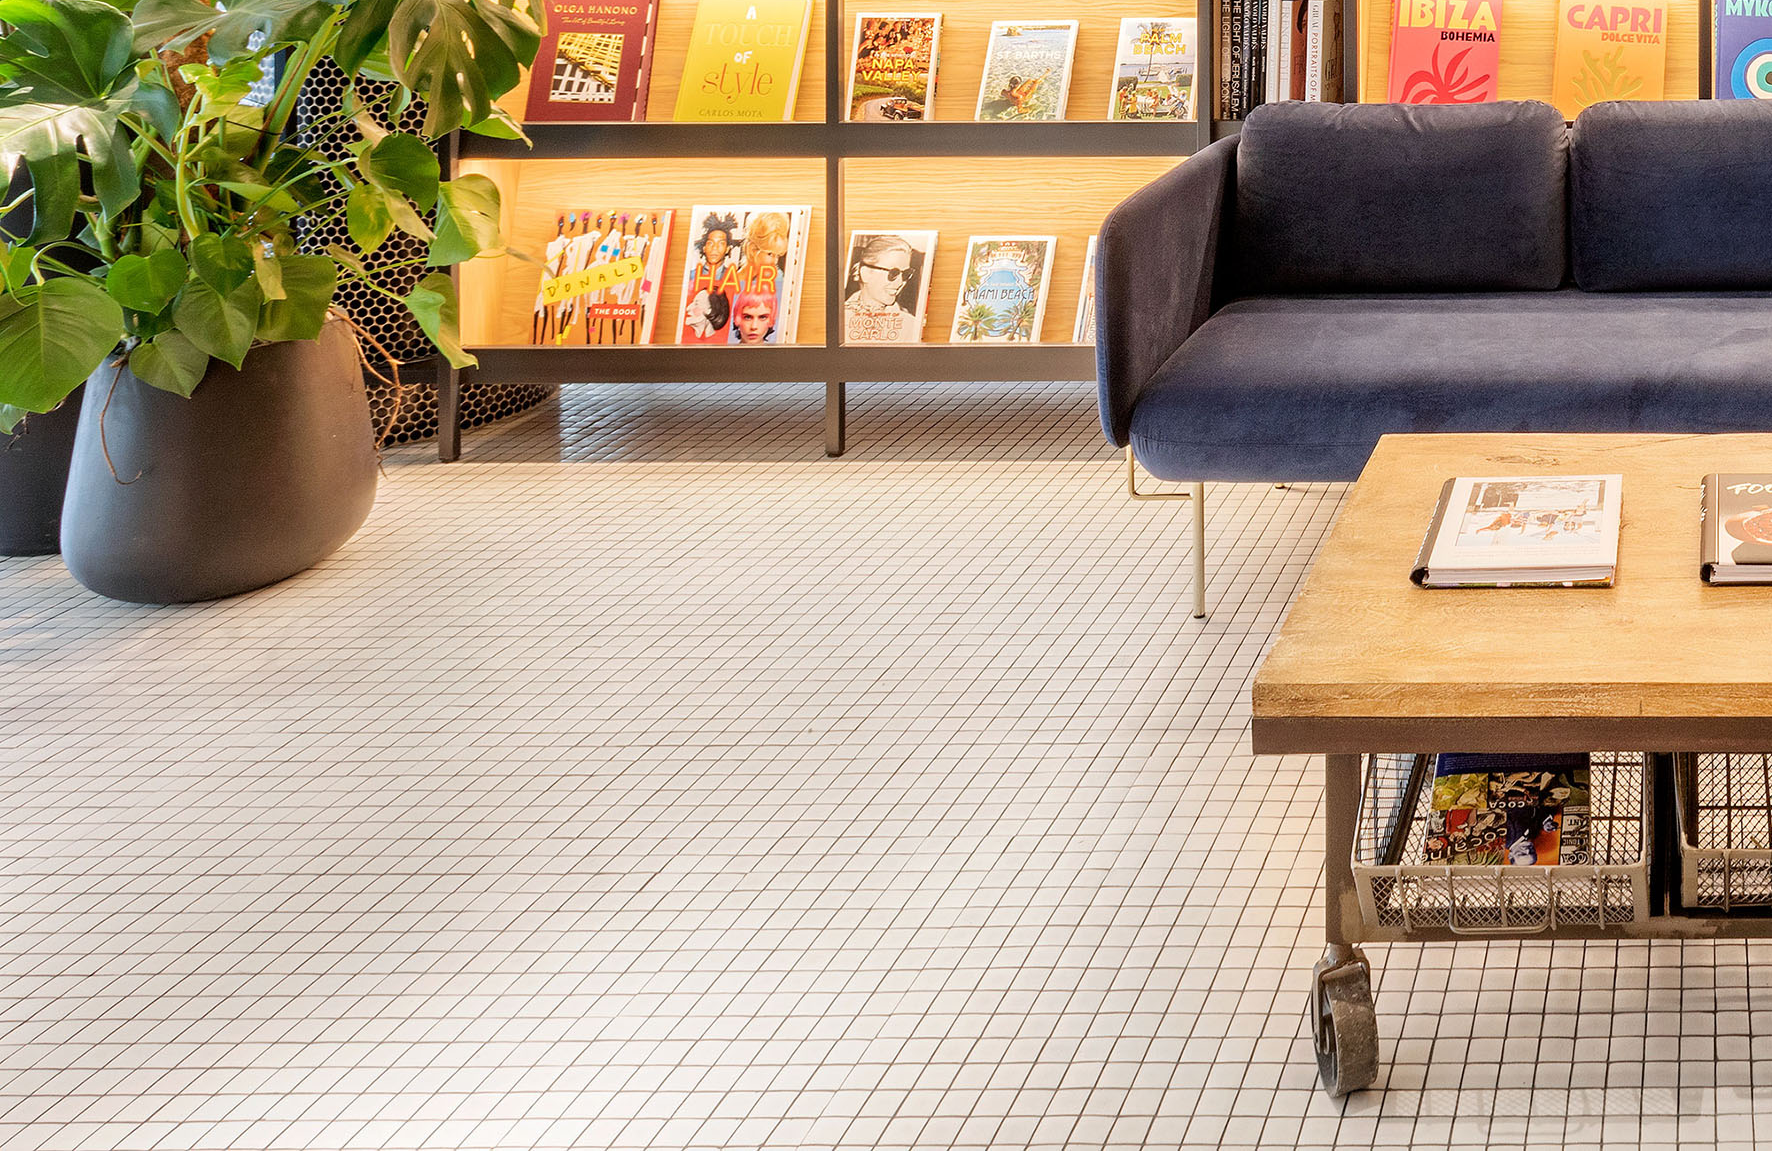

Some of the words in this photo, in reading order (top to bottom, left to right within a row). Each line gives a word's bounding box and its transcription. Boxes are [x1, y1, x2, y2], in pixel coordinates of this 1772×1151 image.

[553, 4, 584, 14] OLGA
[588, 5, 638, 15] HANONO
[745, 5, 758, 20] A
[1567, 4, 1663, 34] CAPRI
[704, 23, 795, 48] TOUCH
[1222, 16, 1230, 43] LIGHT
[1232, 16, 1241, 43] LIGHT
[1139, 33, 1184, 44] PALM
[1440, 30, 1496, 44] BOHEMIA
[1601, 32, 1635, 44] DOLCE
[1636, 33, 1661, 45] VITA
[1014, 50, 1063, 60] BARTHS
[1132, 43, 1187, 55] BEACH
[1232, 46, 1240, 59] OF
[1310, 32, 1318, 78] PORTRAITS
[734, 50, 753, 64] OF
[872, 59, 914, 70] NAPA
[861, 70, 922, 81] VALLEY
[701, 63, 774, 104] style
[1231, 60, 1240, 112] JERUSALEM
[1310, 79, 1318, 91] OF
[698, 108, 734, 117] CARLOS
[736, 109, 763, 118] MOTA
[546, 262, 639, 298] DONALD
[695, 265, 777, 294] HAIR
[966, 288, 999, 300] MIAMI
[1001, 288, 1036, 301] BEACH
[594, 307, 611, 315] THE
[612, 308, 637, 316] BOOK
[848, 317, 904, 330] MONTE
[849, 329, 900, 340] CARLO
[1488, 800, 1525, 809] COCA
